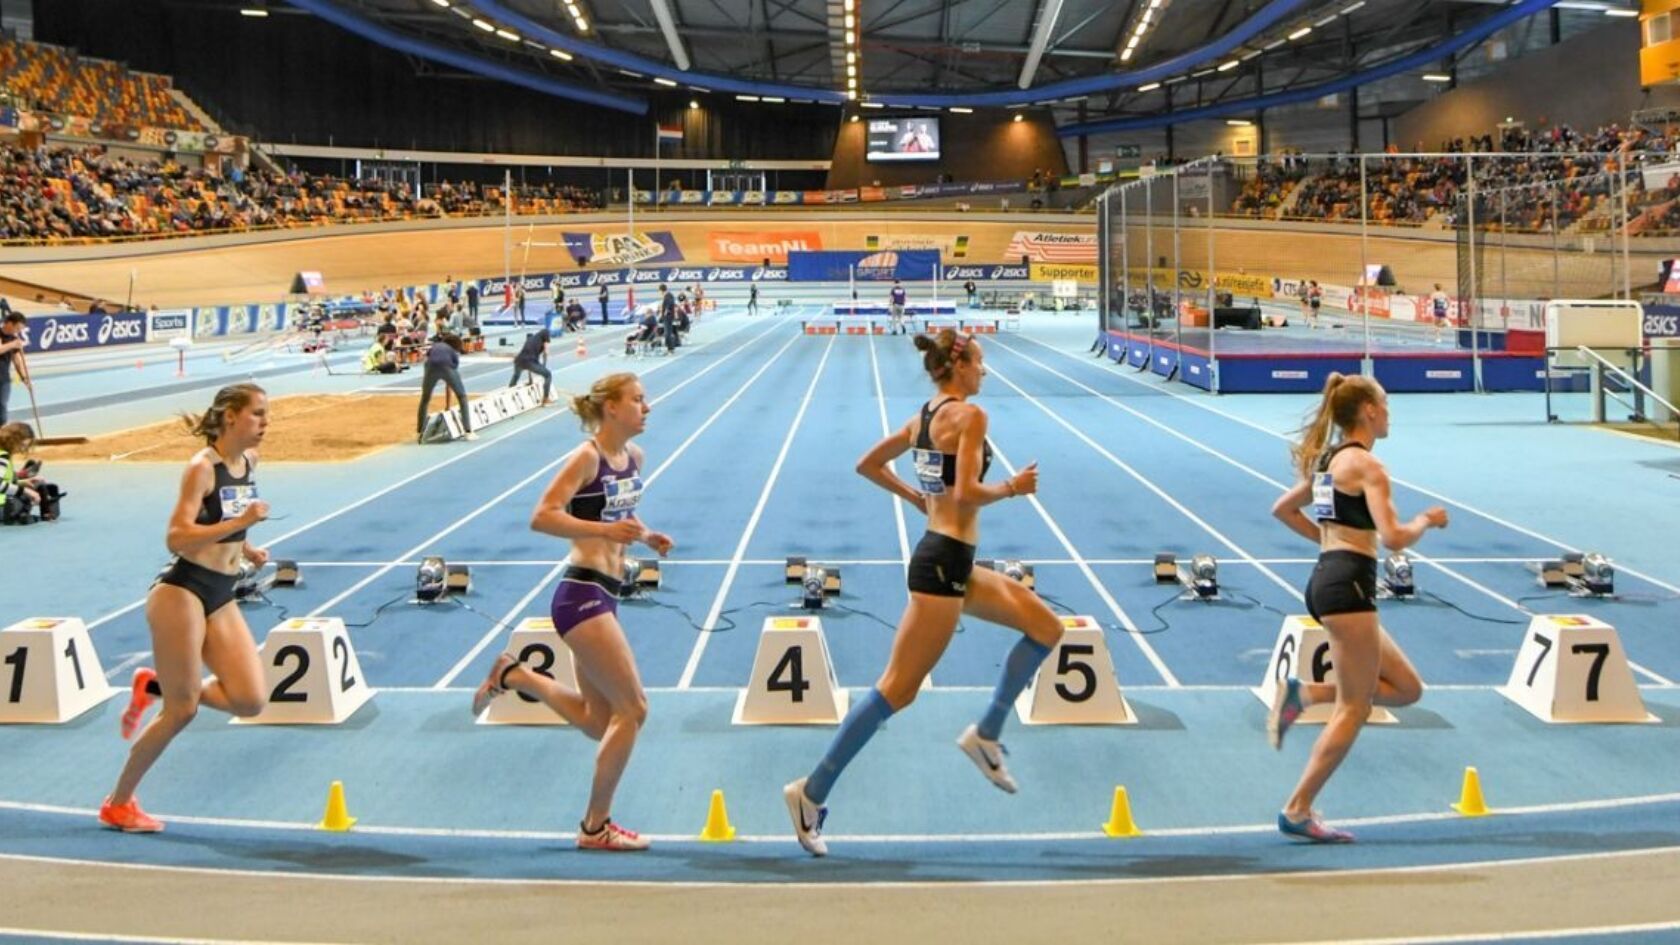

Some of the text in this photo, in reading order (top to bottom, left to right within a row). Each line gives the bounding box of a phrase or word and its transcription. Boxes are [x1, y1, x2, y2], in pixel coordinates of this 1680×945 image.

[637, 270, 660, 280] asics
[679, 270, 703, 280] asics
[720, 269, 745, 280] asics
[763, 269, 787, 279] asics
[958, 266, 983, 278] asics
[1003, 266, 1028, 277] asics
[1040, 266, 1094, 279] Supporter
[154, 316, 185, 329] Sports
[1644, 315, 1678, 334] asics
[474, 403, 489, 424] 15
[4, 646, 29, 703] 1
[64, 638, 85, 690] 1
[269, 644, 310, 702] 2
[333, 635, 356, 693] 2
[517, 643, 555, 703] 3
[766, 645, 810, 703] 4
[1054, 644, 1098, 703] 5
[1275, 634, 1296, 682] 6
[1526, 632, 1553, 688] 7
[1571, 643, 1610, 701] 7
